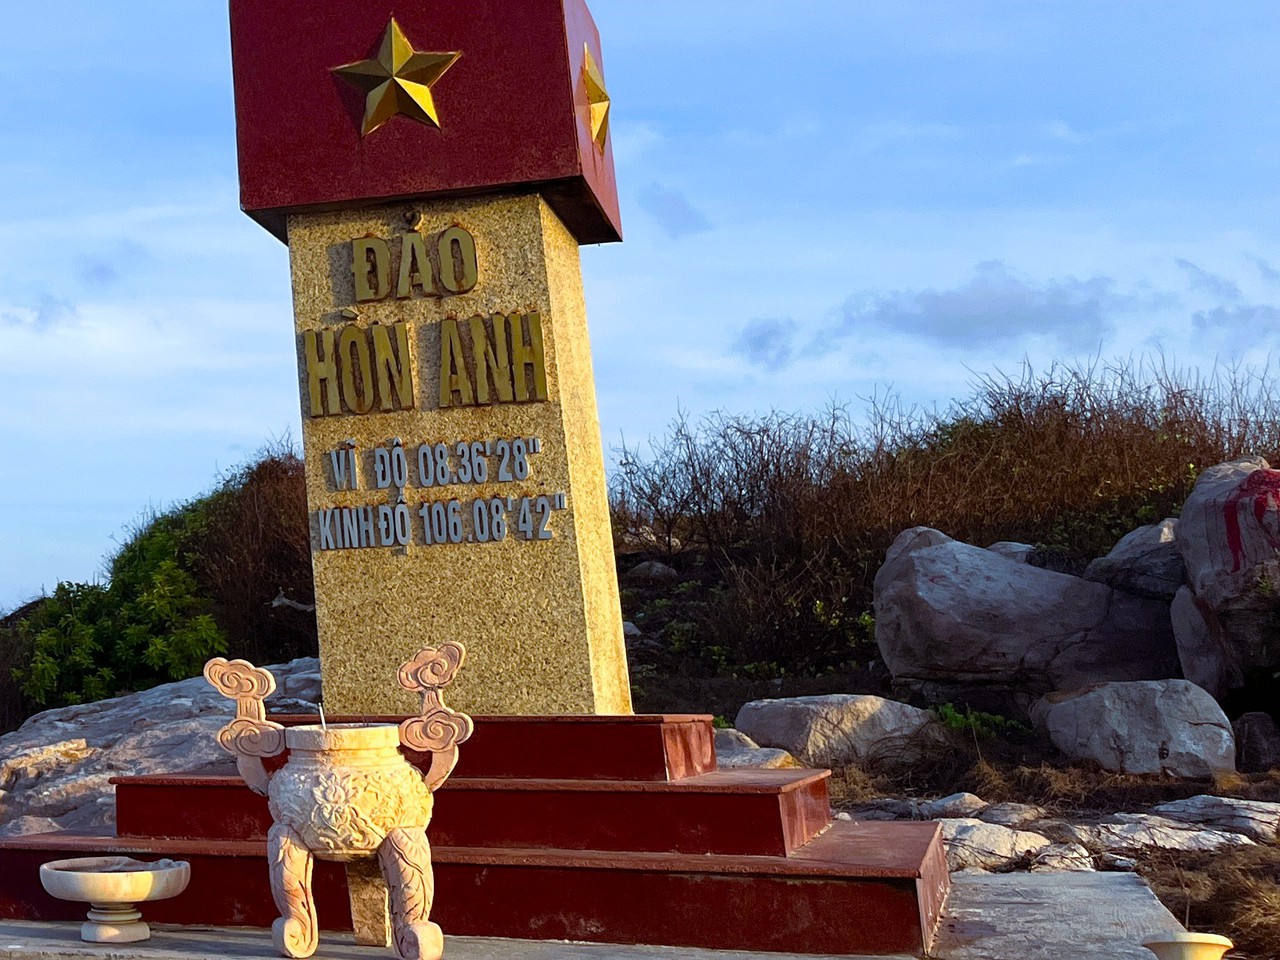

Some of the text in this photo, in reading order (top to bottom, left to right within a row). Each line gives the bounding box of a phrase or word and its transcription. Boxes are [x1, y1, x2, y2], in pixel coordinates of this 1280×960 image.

[351, 210, 478, 303] ĐẢO
[304, 308, 549, 418] HÒN ANH
[374, 436, 408, 495] ĐỘ
[318, 505, 376, 550] KINH
